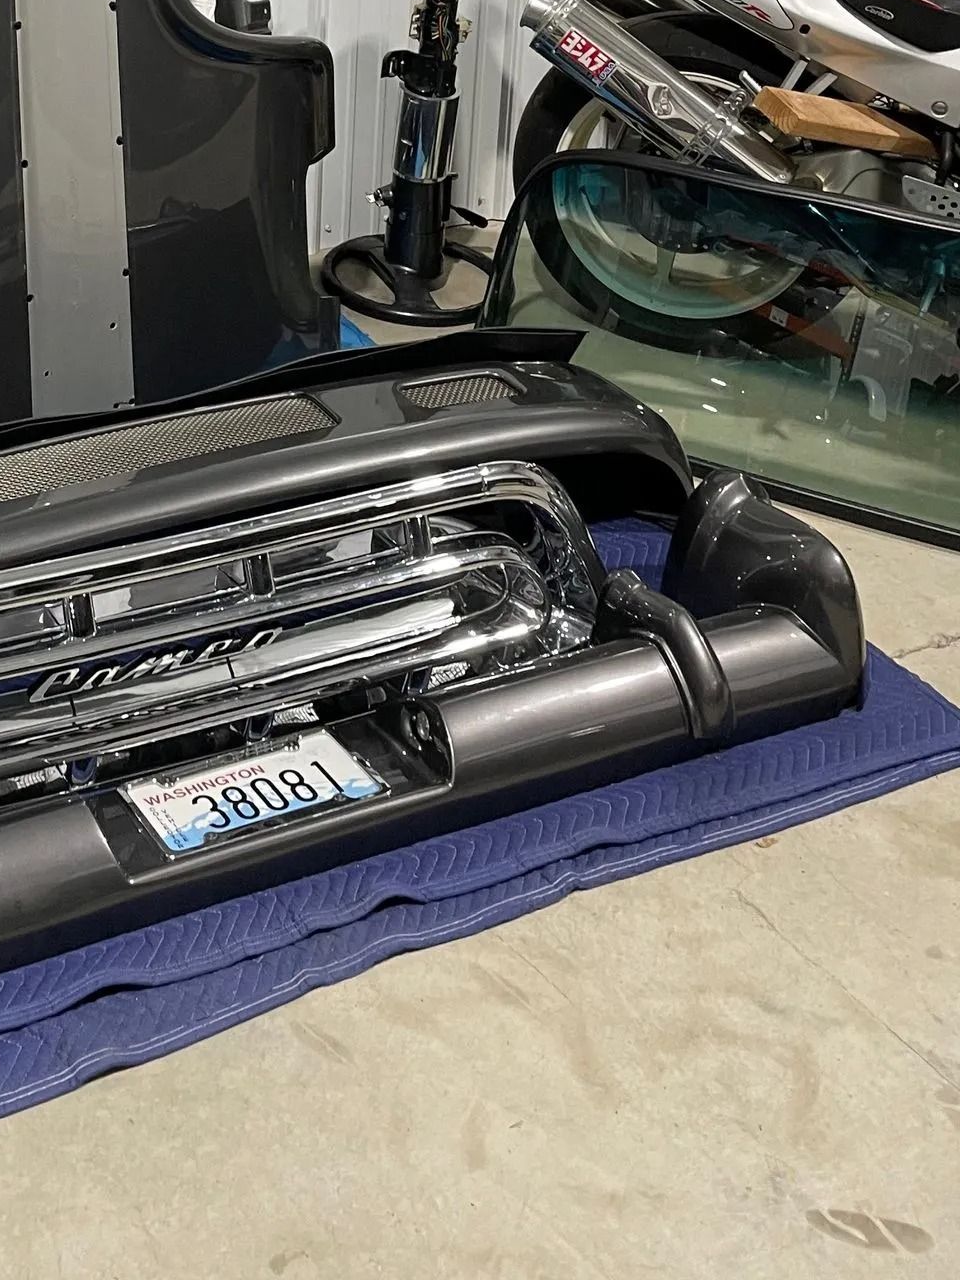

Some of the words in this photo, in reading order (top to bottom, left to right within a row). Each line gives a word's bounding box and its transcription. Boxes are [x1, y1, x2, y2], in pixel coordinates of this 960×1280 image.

[560, 31, 609, 72] ヨシムラ
[28, 626, 282, 703] Cameo
[143, 765, 266, 806] WASHINGTON
[191, 761, 345, 829] 38081
